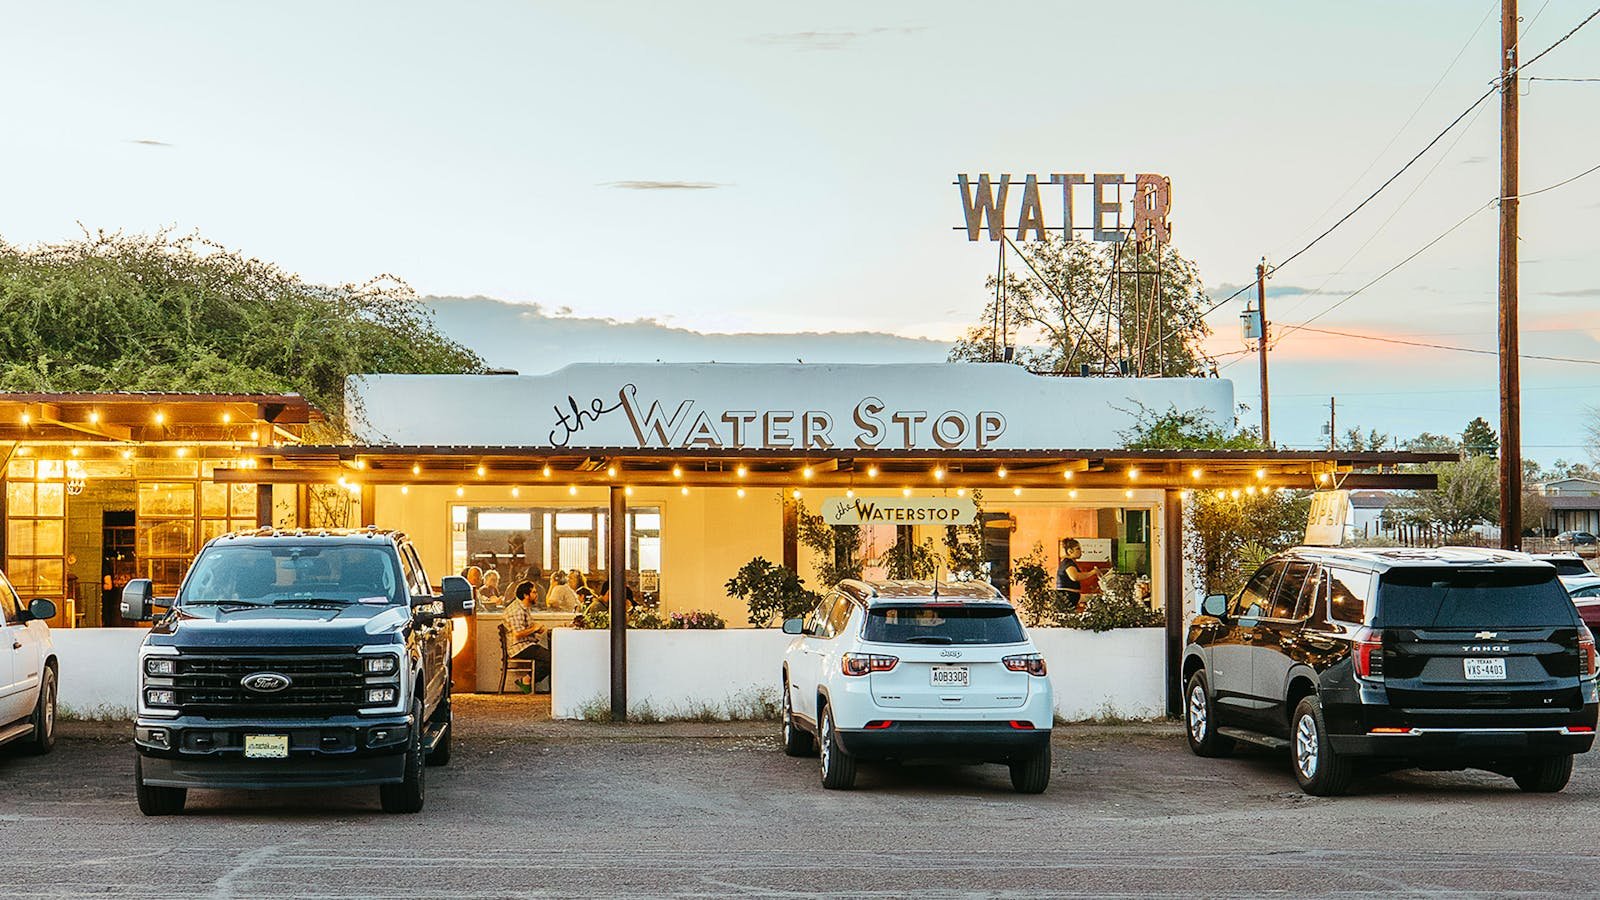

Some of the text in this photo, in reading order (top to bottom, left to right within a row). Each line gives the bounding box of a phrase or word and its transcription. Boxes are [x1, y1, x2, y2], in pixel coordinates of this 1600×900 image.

[957, 173, 1172, 244] WATER
[549, 395, 622, 447] the
[853, 396, 1007, 449] STOP
[835, 502, 857, 521] the
[940, 649, 963, 659] Jeep
[254, 677, 279, 689] Ford
